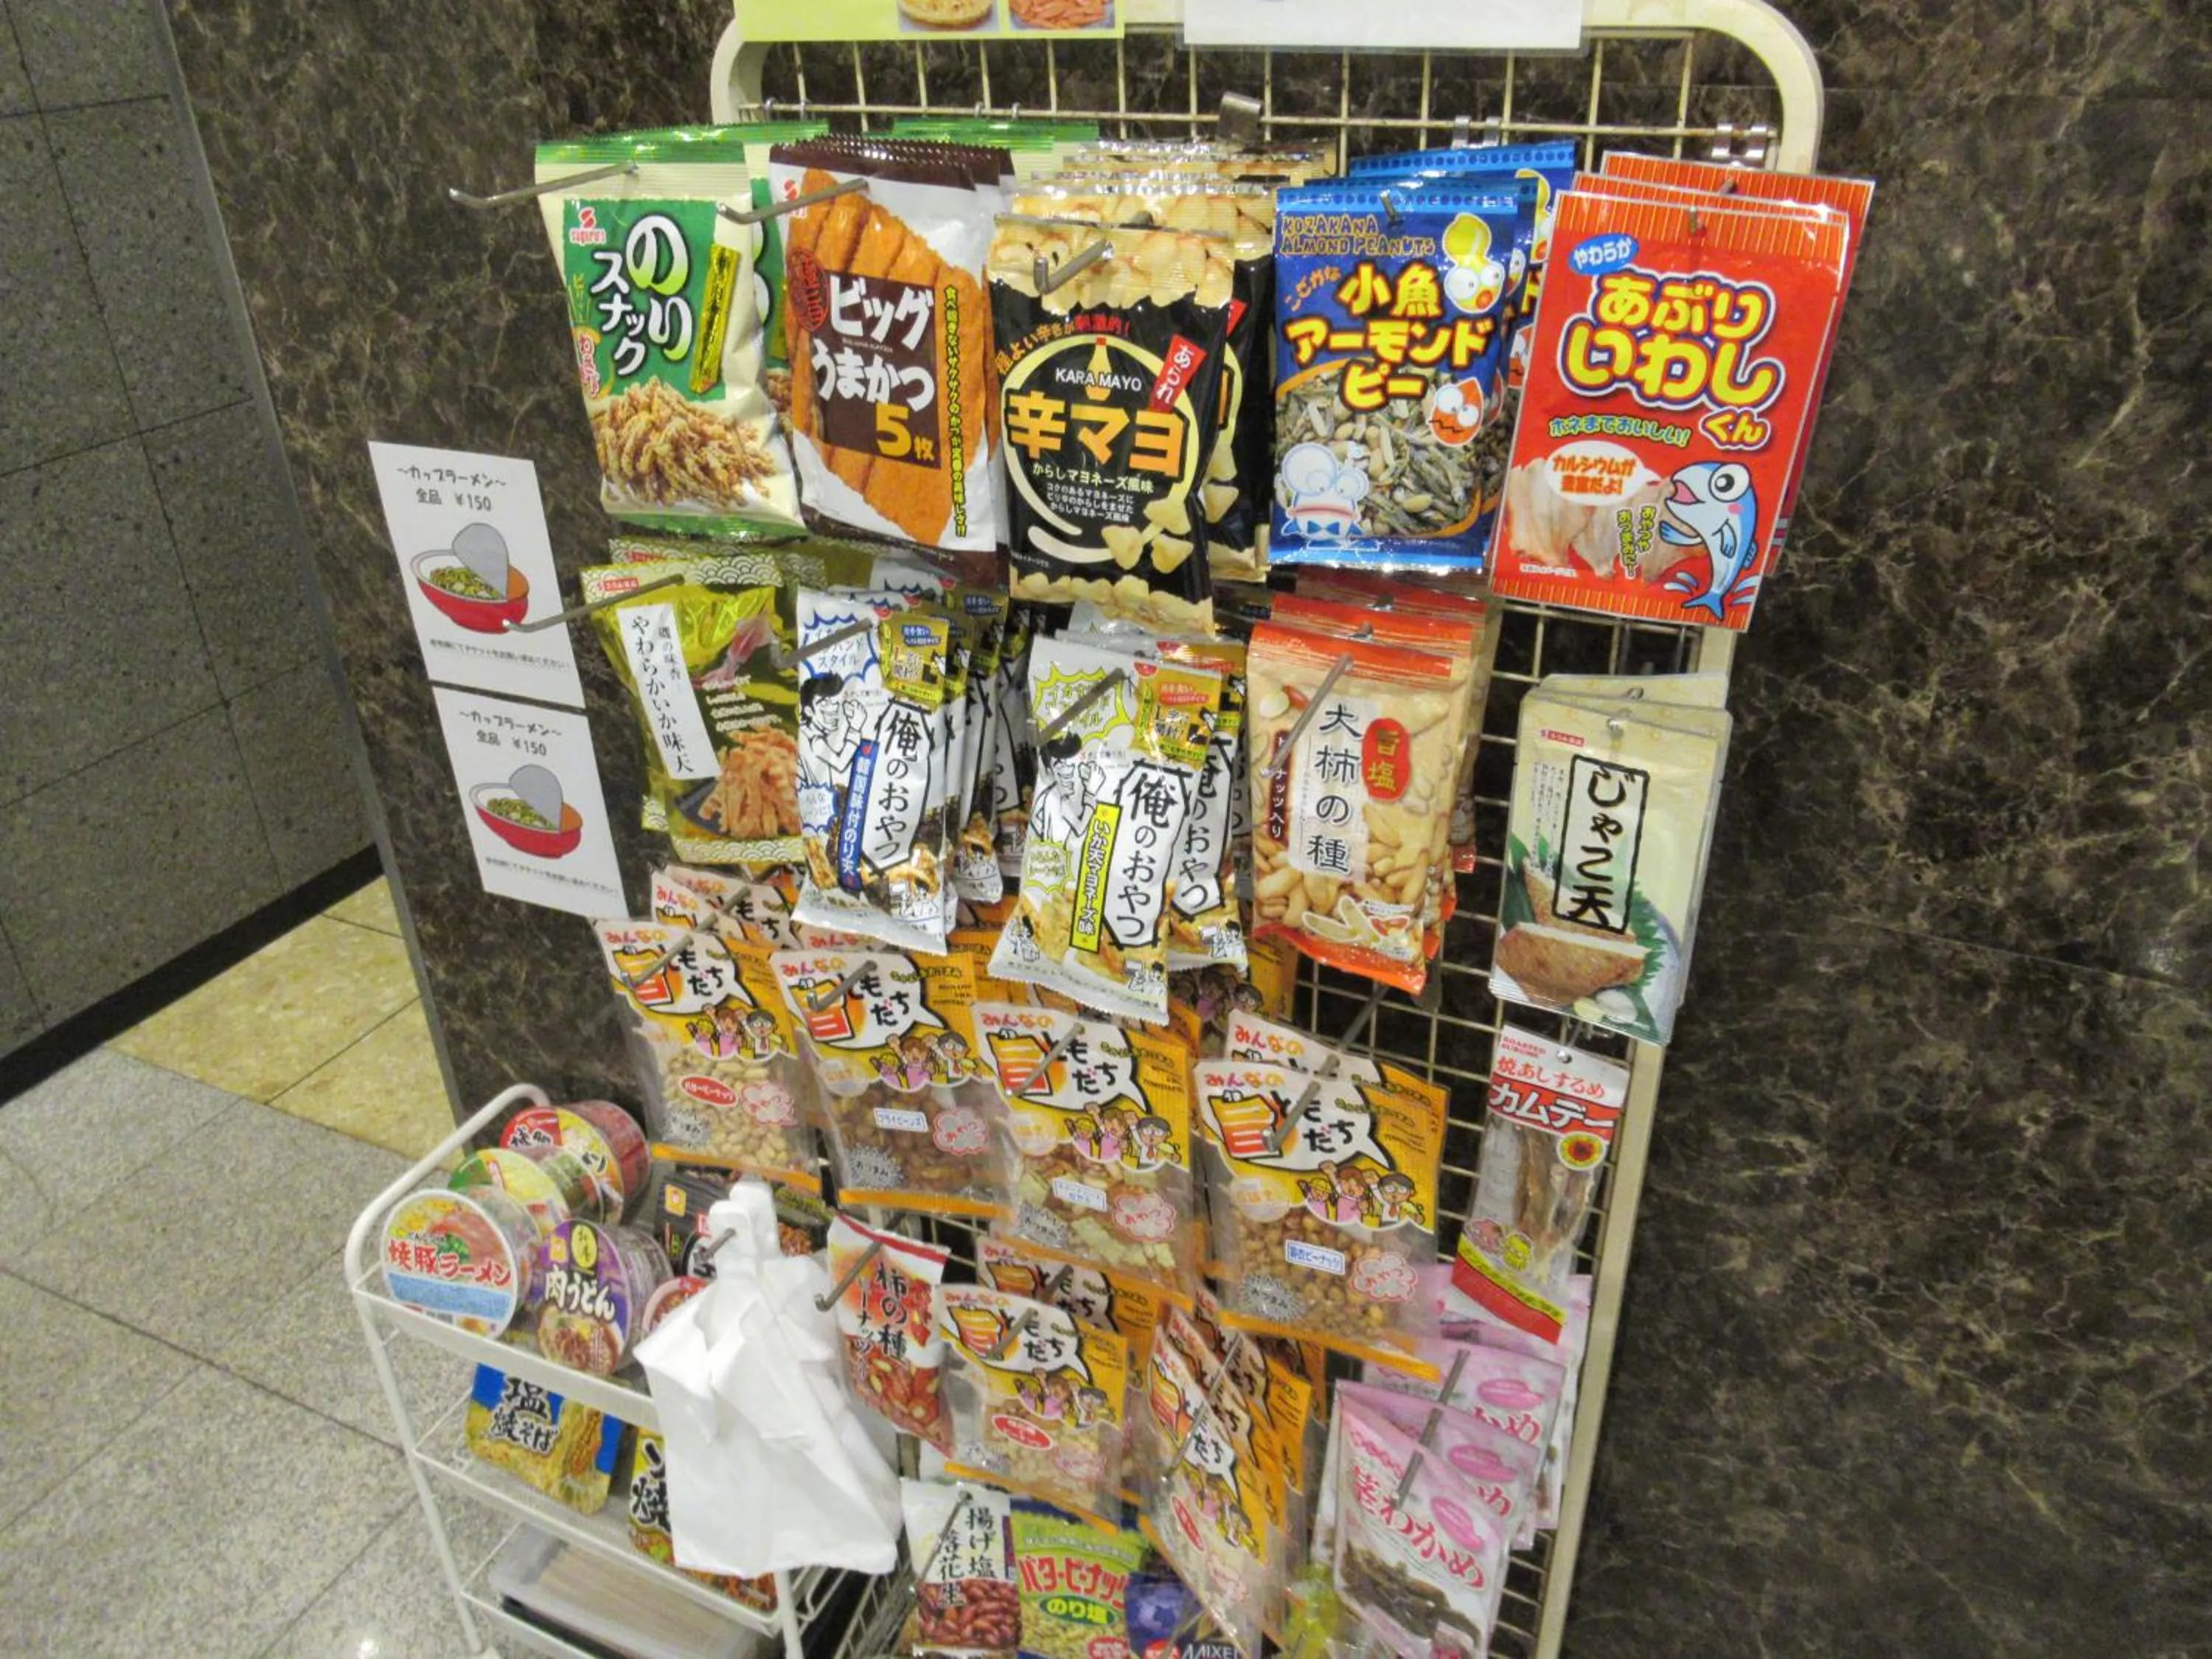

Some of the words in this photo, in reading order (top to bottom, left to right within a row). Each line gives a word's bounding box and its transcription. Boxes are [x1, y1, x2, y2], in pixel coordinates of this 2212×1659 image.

[1281, 214, 1379, 234] KOZAKANA
[1281, 236, 1349, 255] ALMOND
[1573, 238, 1632, 269] やわらか
[591, 251, 647, 375] スナック
[625, 214, 692, 361] のり
[829, 273, 935, 351] ビッグ
[1339, 263, 1441, 317] 小魚
[1599, 275, 1765, 338] あぶり
[811, 337, 936, 413] うまかつ
[1284, 319, 1492, 367] アーモンド
[1565, 329, 1773, 404] いわし
[1342, 364, 1425, 409] ピー
[875, 403, 935, 462] 5枚
[1007, 391, 1185, 478] 辛マヨ
[1705, 413, 1767, 443] くん
[1032, 463, 1155, 494] からしマヨネーズ風味
[631, 614, 695, 774] やわらかいか味天
[874, 709, 923, 860] 俺のおやつ
[1271, 736, 1288, 840] ナッツ入り
[1306, 701, 1363, 874] 大柿の種
[1367, 727, 1402, 793] 旨塩
[1116, 774, 1178, 938] 俺のおやつ
[1569, 766, 1637, 930] じゃこ天
[1489, 1082, 1615, 1129] カムデー
[388, 1239, 512, 1287] 焼豚ラーメン
[544, 1263, 616, 1322] 肉うどん
[965, 1506, 997, 1580] 揚げ塩
